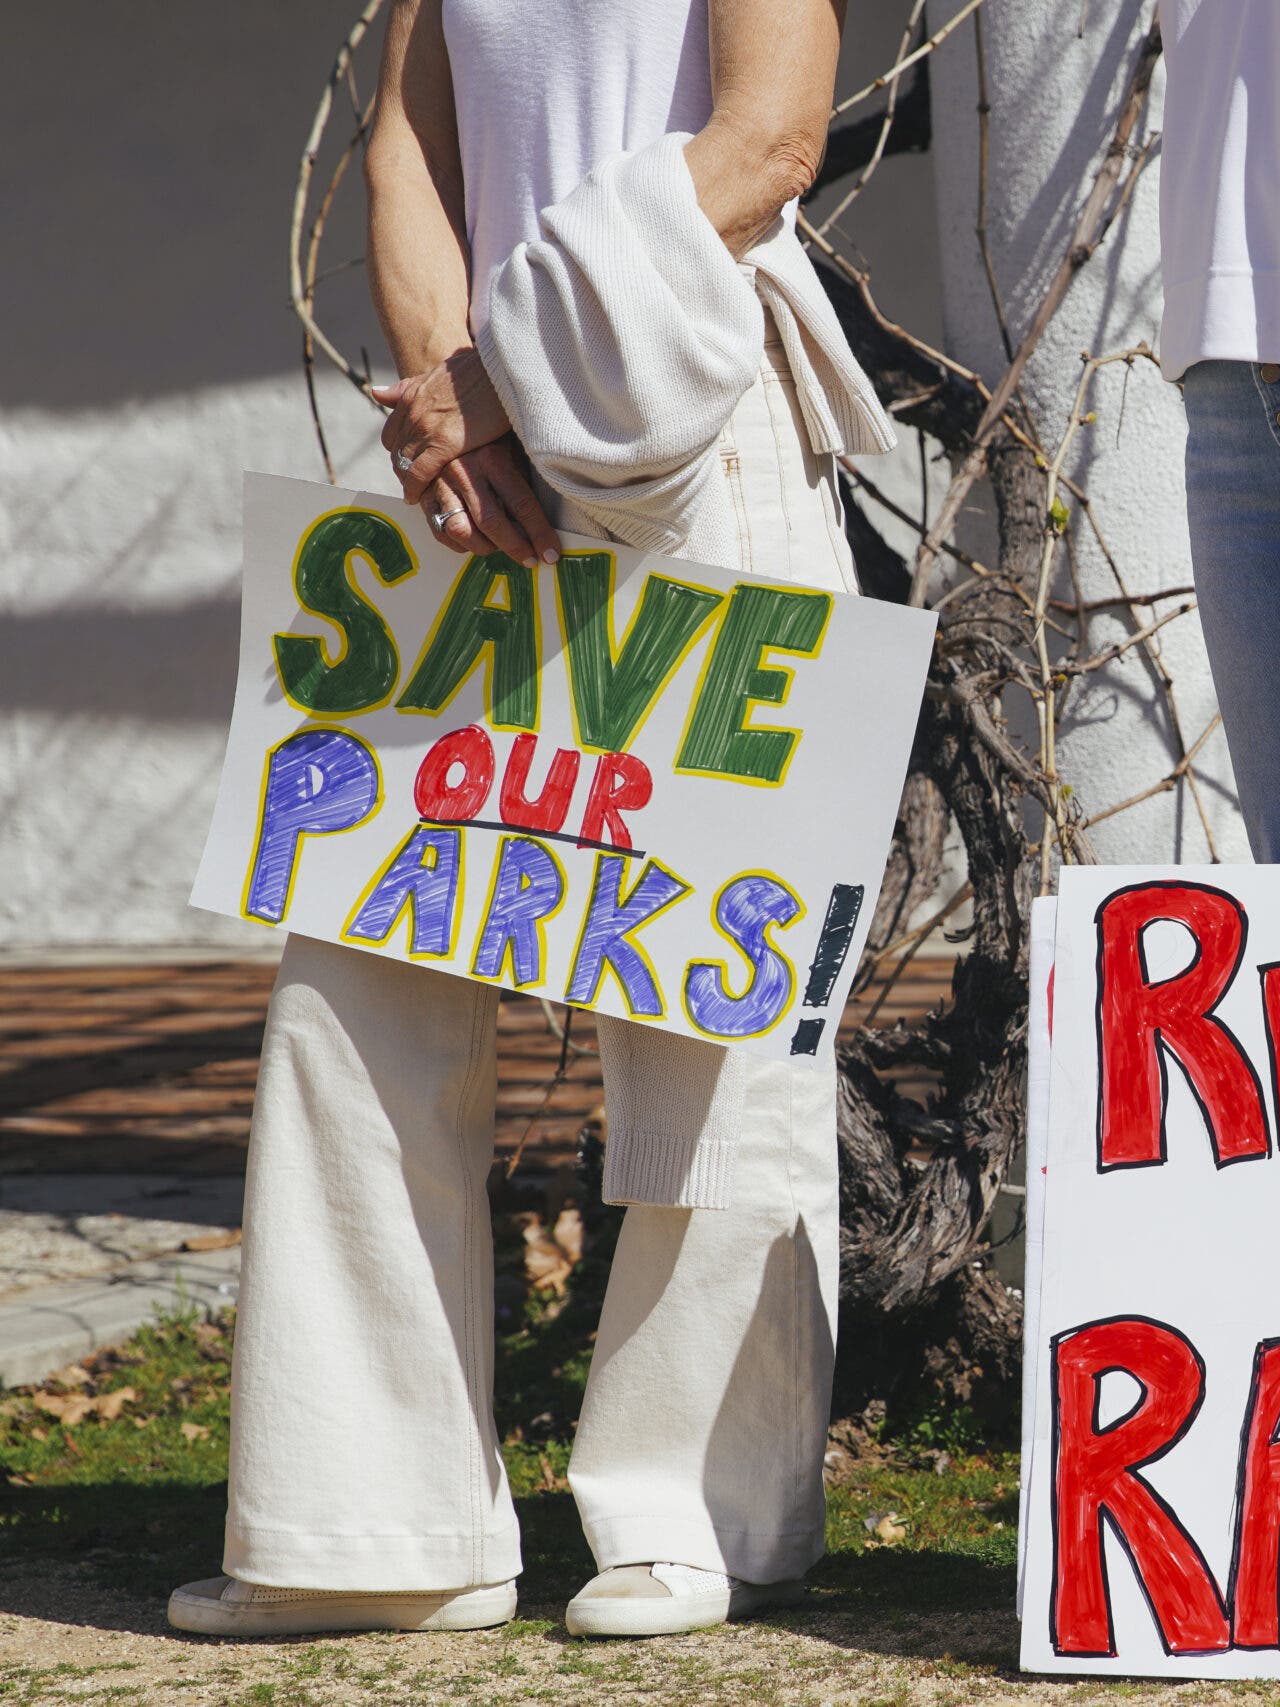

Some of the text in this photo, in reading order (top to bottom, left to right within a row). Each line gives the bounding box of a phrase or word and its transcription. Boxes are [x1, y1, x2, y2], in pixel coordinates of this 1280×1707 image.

[272, 506, 833, 787] SAVE
[413, 723, 654, 850] OUR
[242, 726, 865, 1057] PARKS!
